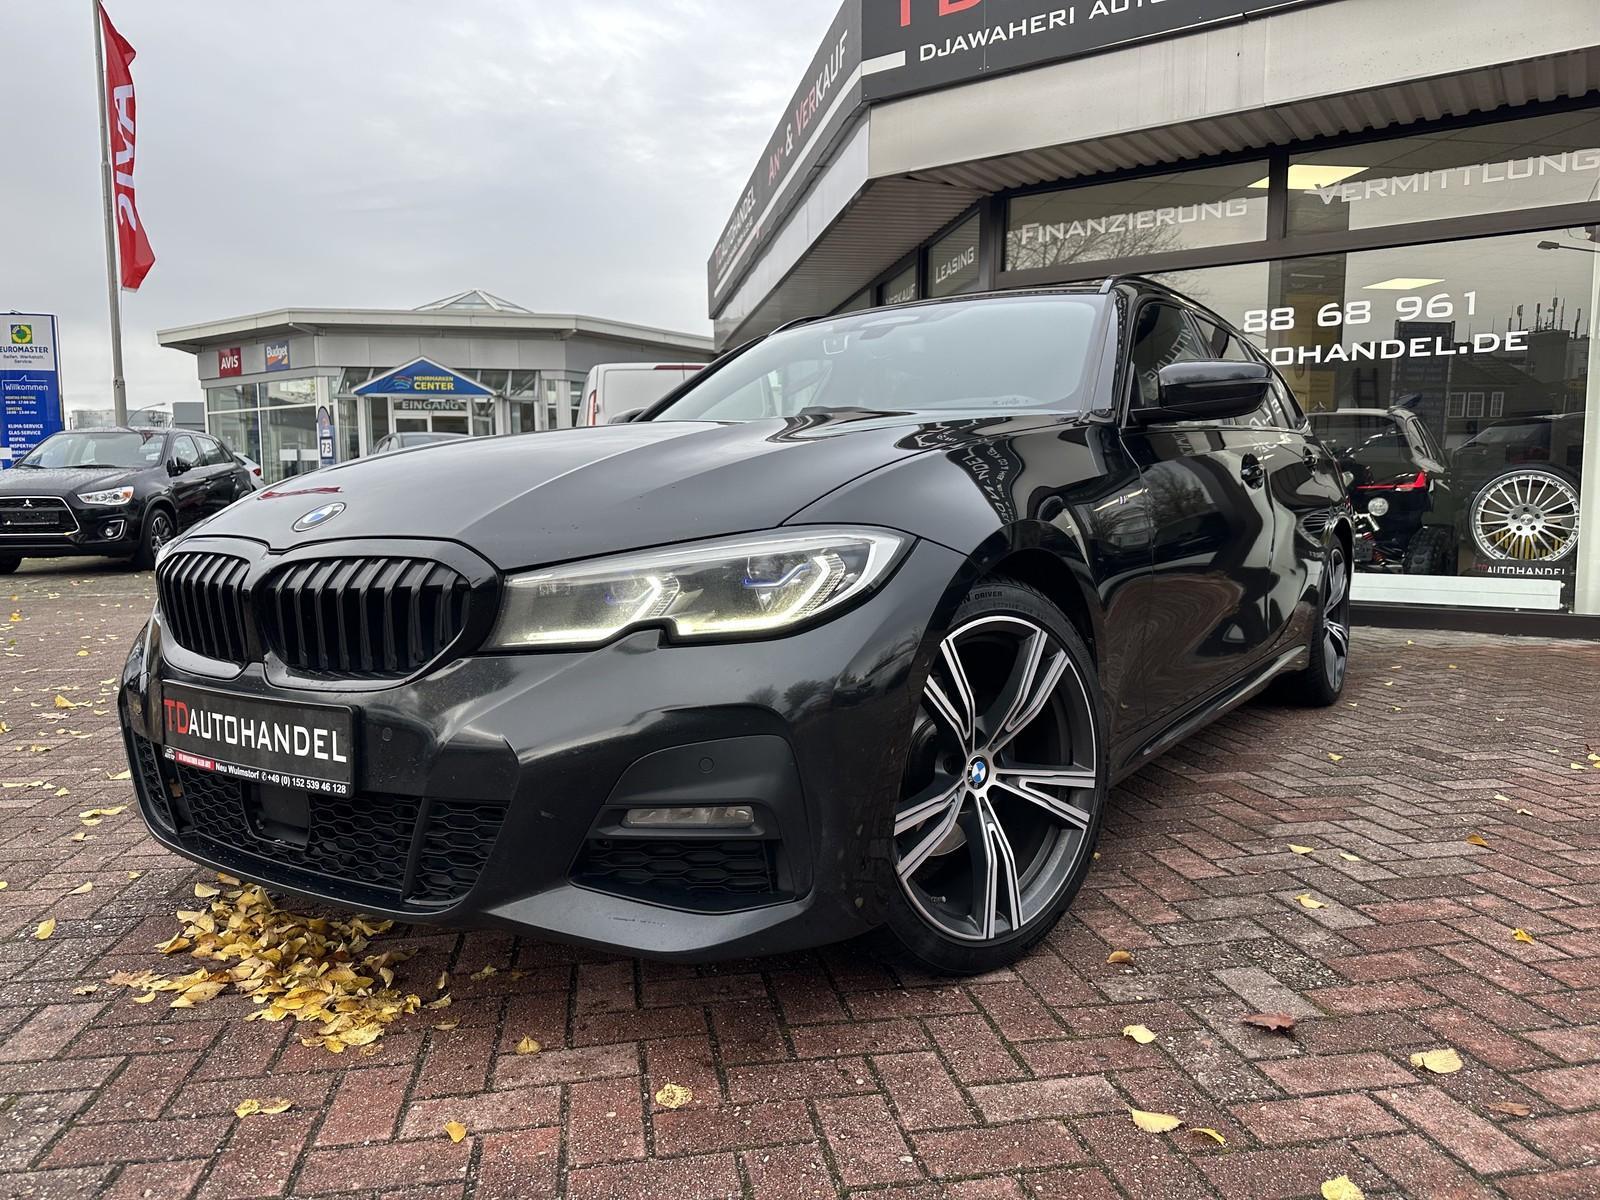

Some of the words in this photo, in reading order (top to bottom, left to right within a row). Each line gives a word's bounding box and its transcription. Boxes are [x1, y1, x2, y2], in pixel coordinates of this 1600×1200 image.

[919, 6, 1076, 62] DJAWAHERI
[784, 122, 794, 158] &
[794, 29, 849, 137] VERKAUF
[1314, 147, 1600, 205] VERMITTLUNG
[1021, 196, 1248, 246] FINANZIERUNG
[935, 246, 975, 284] LEASING
[1243, 307, 1295, 333] 88
[1317, 300, 1371, 327] 68
[1396, 291, 1477, 322] 961
[221, 355, 239, 369] AVIS
[266, 345, 288, 359] Budget
[1260, 330, 1529, 367] OHANDEL.DE
[4, 383, 48, 391] Willkommen
[413, 382, 454, 391] CENTER
[402, 400, 459, 410] EINGANG
[321, 443, 331, 454] 73
[974, 591, 1002, 600] DRIVER
[163, 699, 347, 763] TDAUTOHANDEL
[215, 763, 227, 774] Neu
[228, 765, 260, 780] Wulmstorf
[267, 774, 280, 784] +49
[281, 776, 291, 786] (0)
[292, 779, 305, 788] 152
[306, 780, 320, 790] 539
[320, 782, 331, 792] 46
[332, 784, 347, 794] 128
